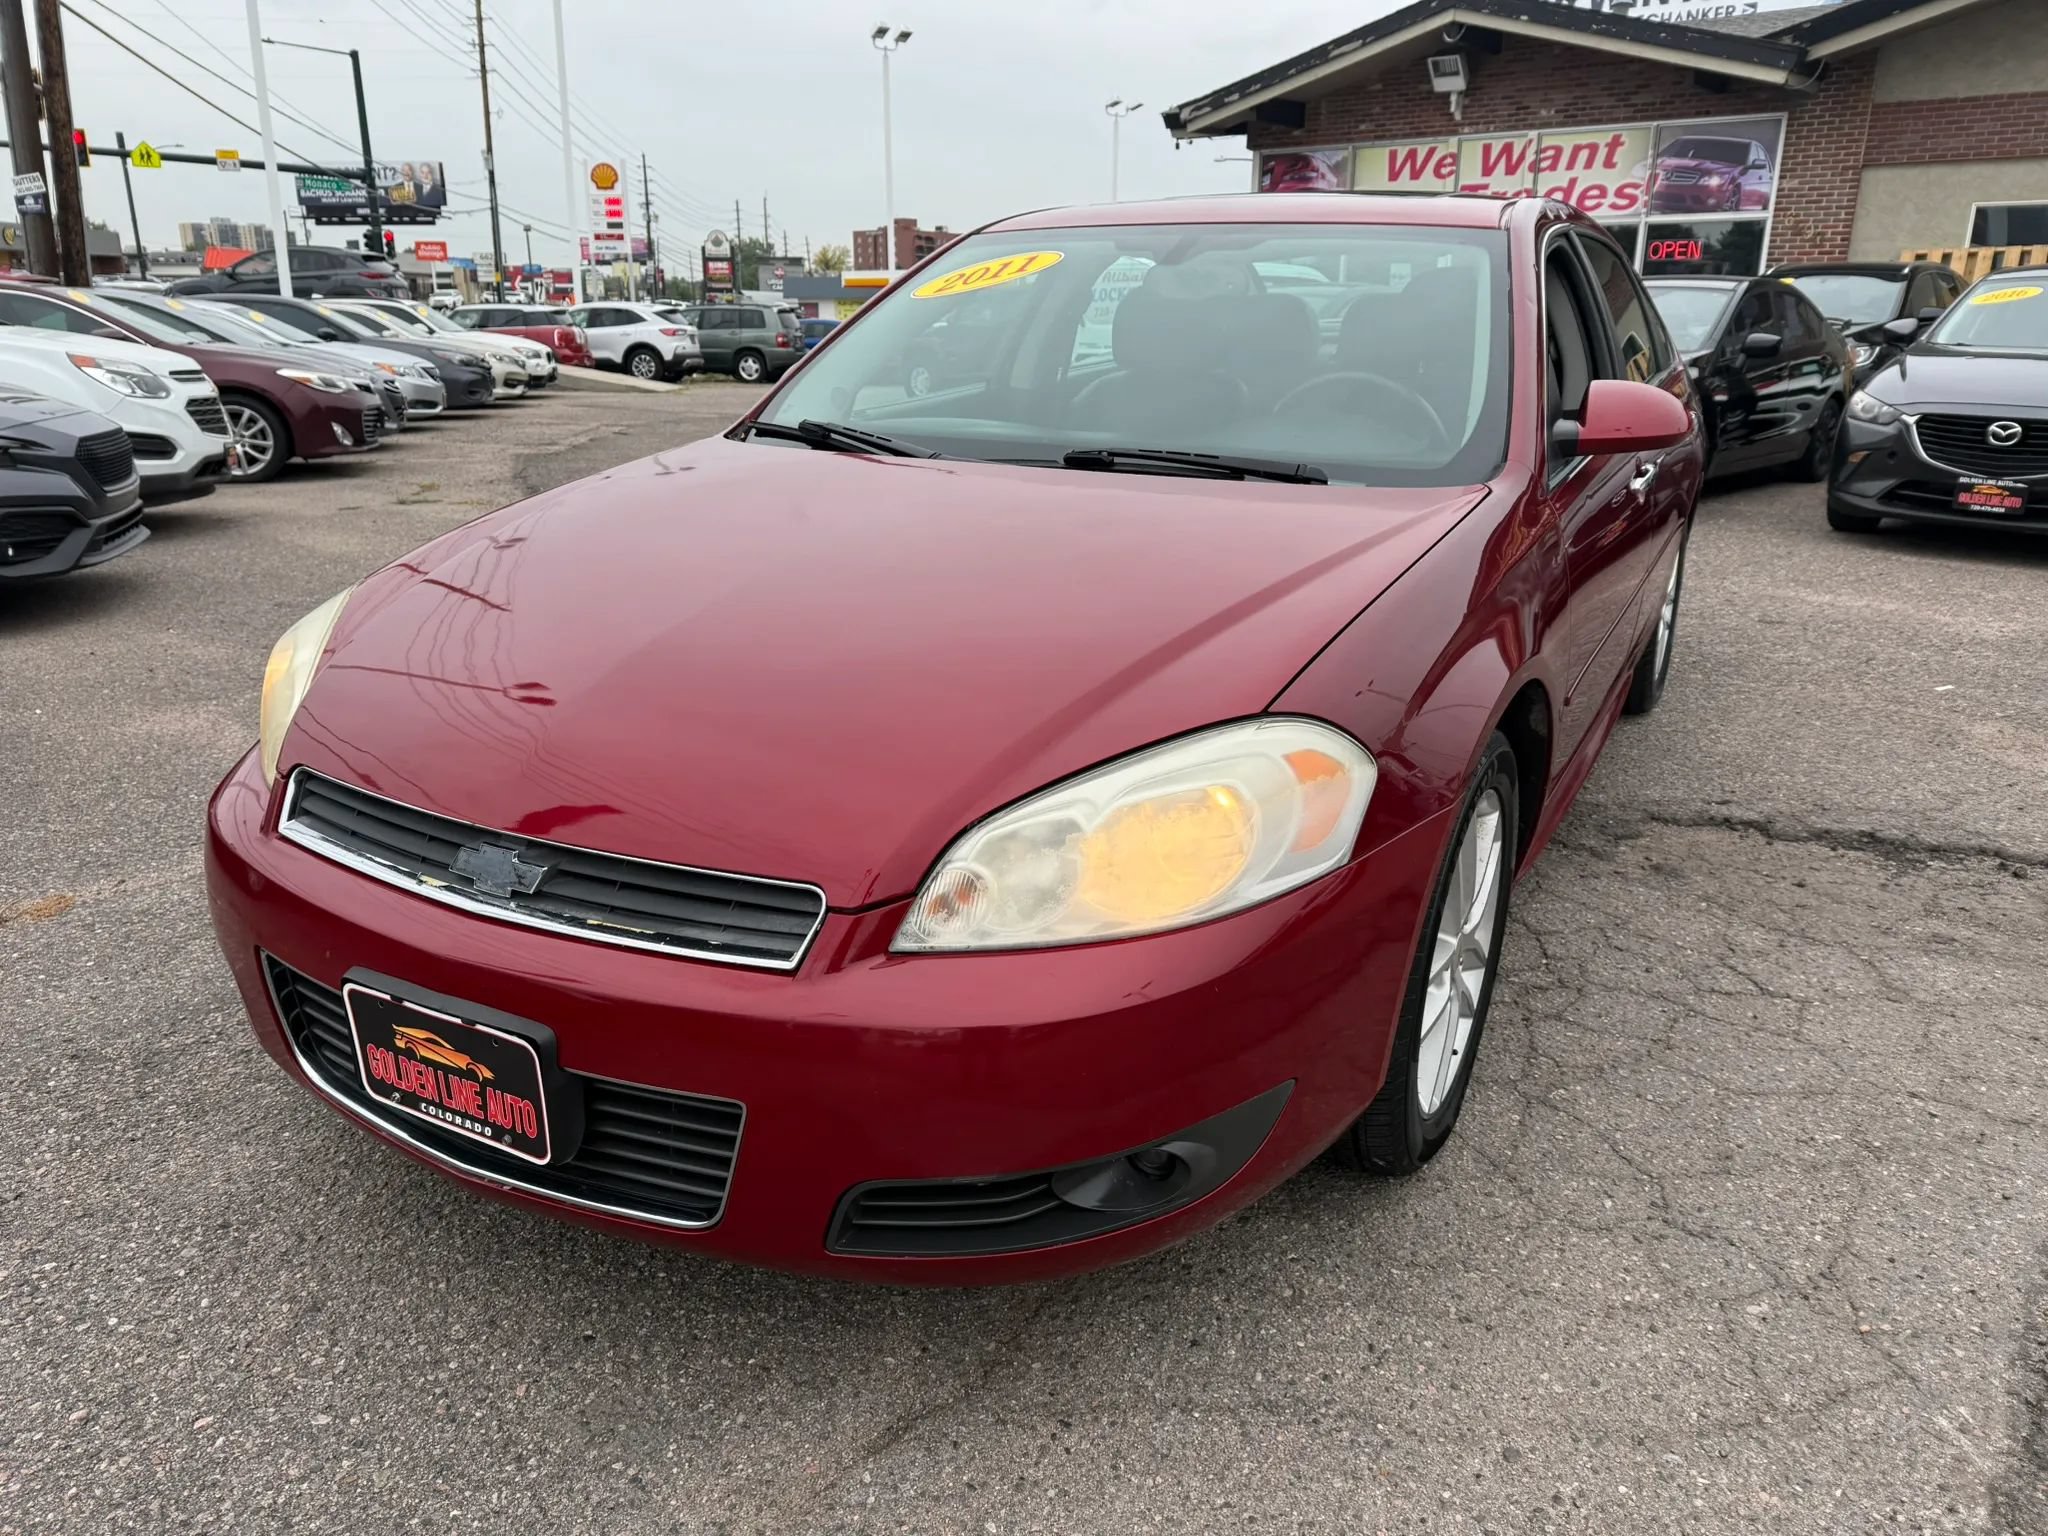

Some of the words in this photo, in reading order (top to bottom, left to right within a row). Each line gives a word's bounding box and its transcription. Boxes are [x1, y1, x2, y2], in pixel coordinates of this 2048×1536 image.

[1637, 5, 1736, 23] CHANKER
[1388, 145, 1457, 182] We
[1481, 133, 1625, 177] Want
[305, 178, 337, 189] Monaco
[1460, 172, 1660, 212] des!
[1649, 239, 1703, 260] OPEN
[933, 254, 1040, 294] 2011
[1958, 492, 1986, 505] GOLDEN
[1987, 494, 2002, 506] LINE
[2003, 497, 2022, 508] AUTO
[366, 1043, 440, 1103] GOLDEN
[437, 1070, 484, 1120] LINE
[487, 1086, 538, 1139] AUTO
[420, 1102, 493, 1138] COLORADO
